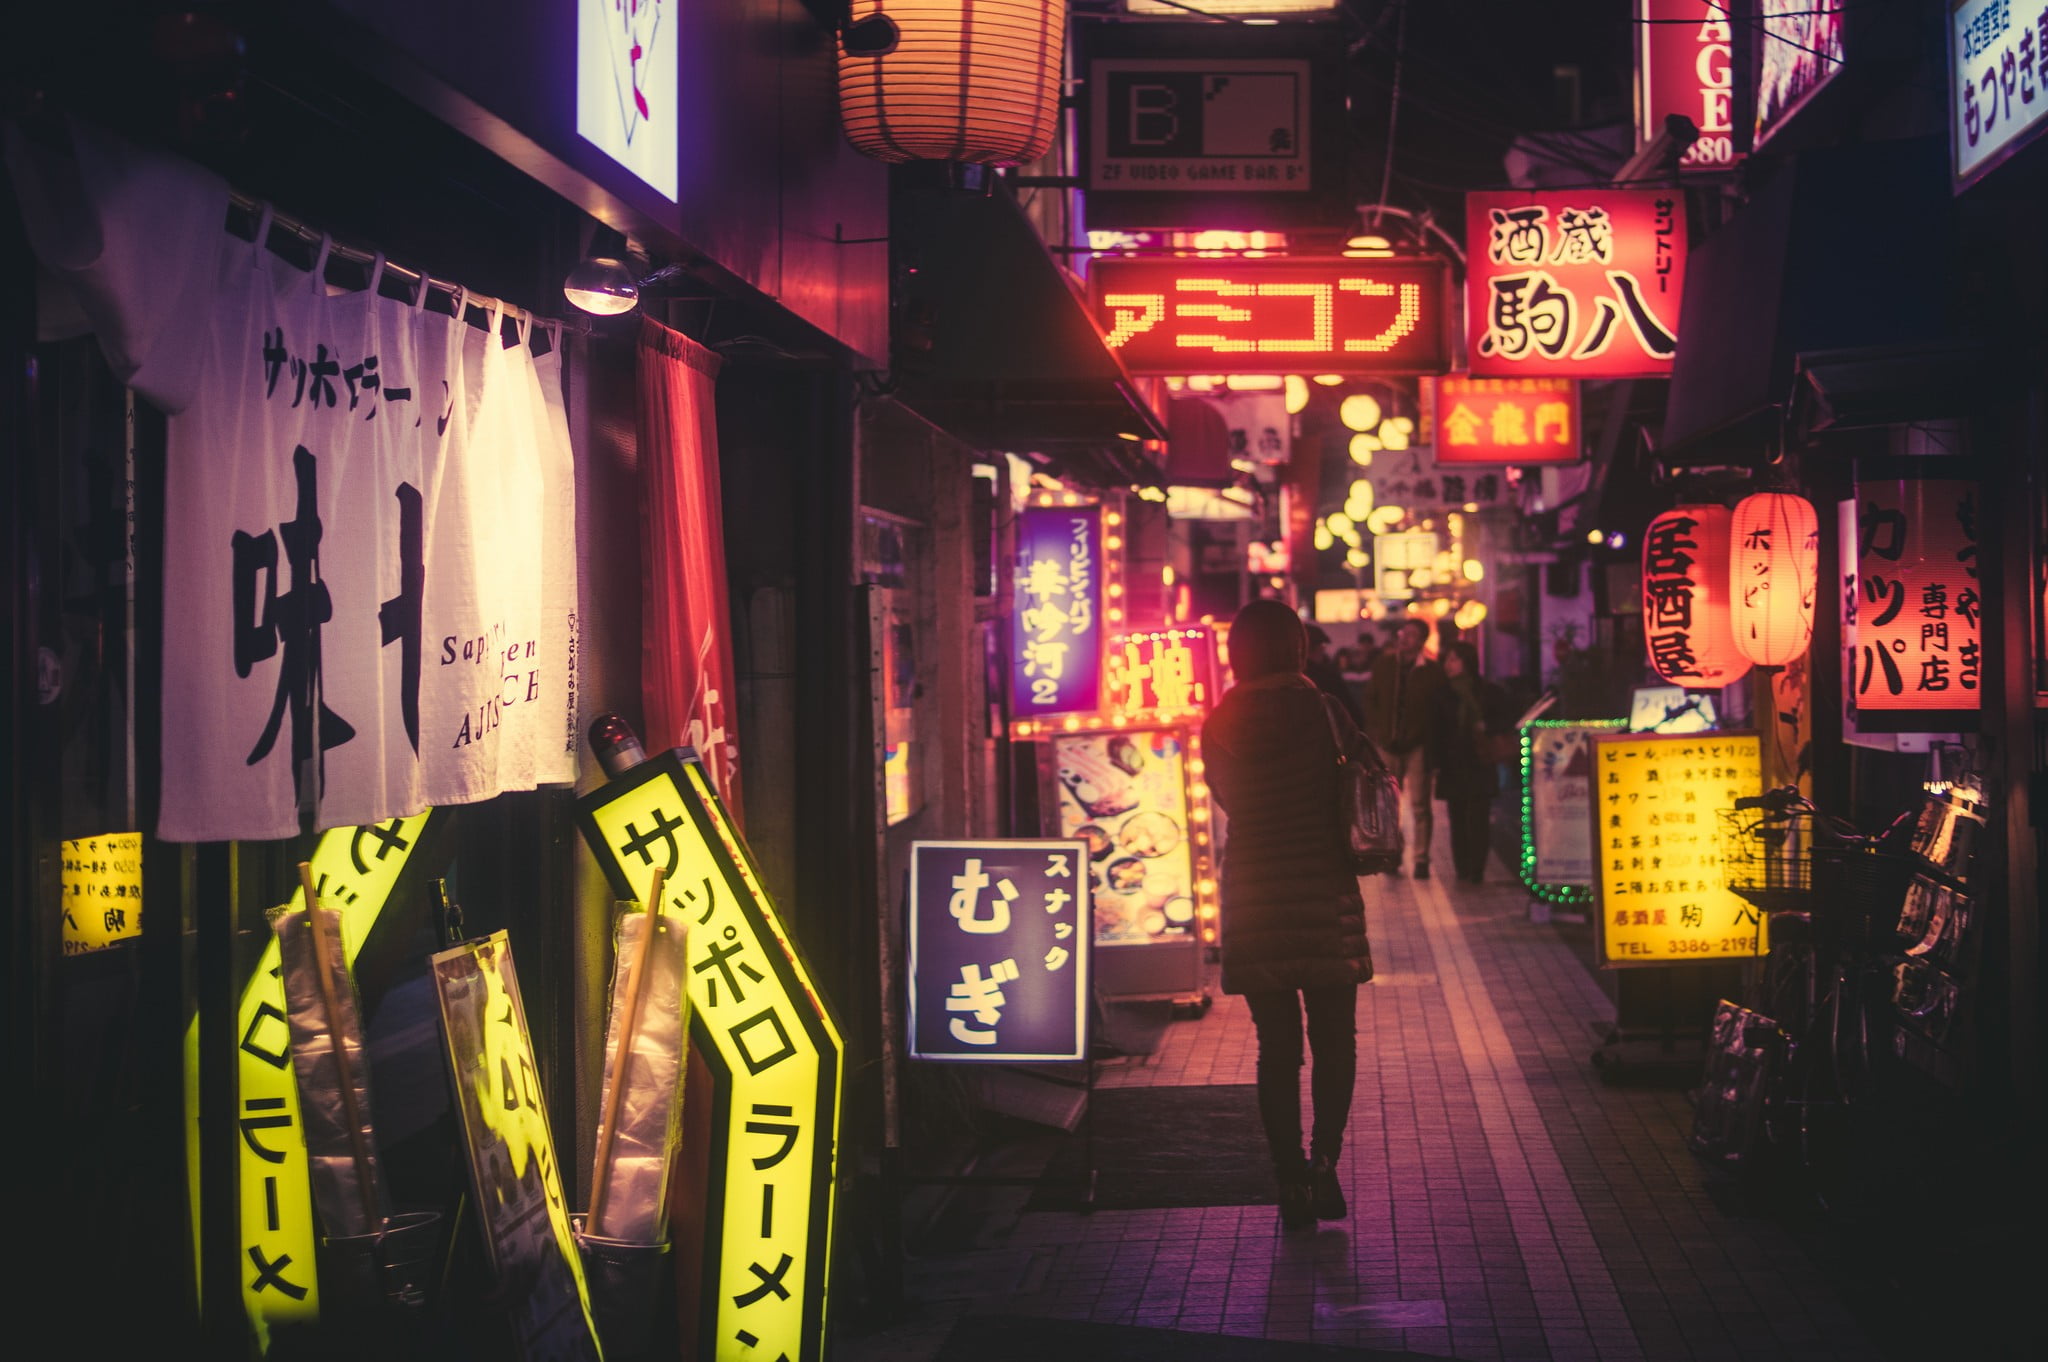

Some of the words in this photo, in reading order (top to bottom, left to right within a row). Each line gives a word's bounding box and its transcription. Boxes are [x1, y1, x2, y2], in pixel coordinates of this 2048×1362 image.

[1129, 84, 1179, 146] B
[1130, 164, 1180, 180] VIDEO
[1187, 164, 1236, 180] GAME
[1244, 164, 1280, 180] BAR
[1489, 206, 1613, 266] 酒蔵
[1478, 270, 1677, 361] 駒八
[262, 326, 454, 437] サッポロラーン
[1744, 523, 1772, 640] ホッピー
[1860, 502, 1906, 696] カッパ
[1918, 583, 1950, 692] 専門店
[946, 858, 1020, 1045] むぎ
[1044, 855, 1073, 971] スナック
[1616, 942, 1652, 954] TEL
[1668, 937, 1757, 953] 3386-2198
